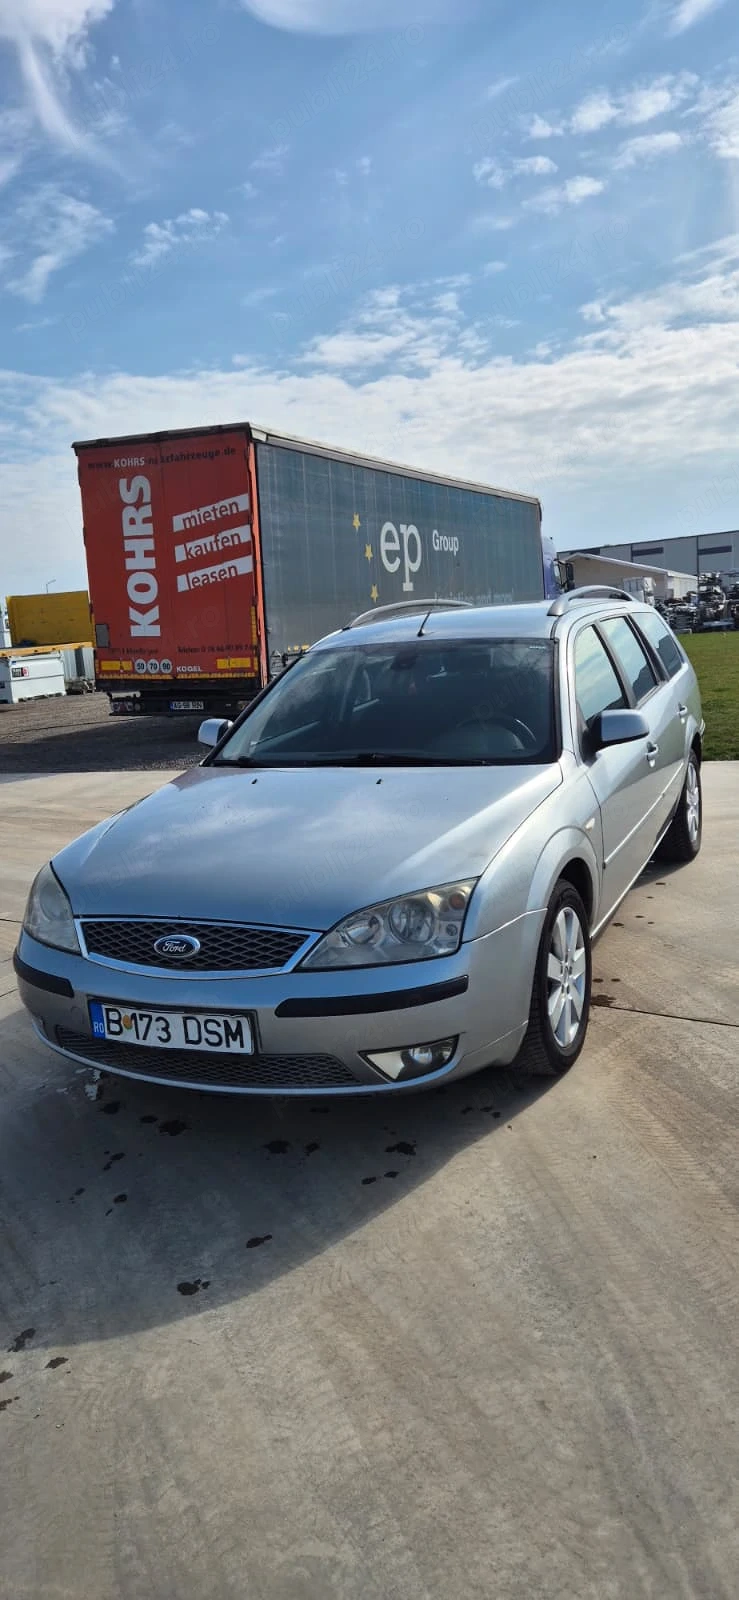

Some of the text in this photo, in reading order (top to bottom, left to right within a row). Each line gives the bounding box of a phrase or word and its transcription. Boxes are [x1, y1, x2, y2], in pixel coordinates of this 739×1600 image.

[182, 501, 239, 528] mieten
[119, 475, 161, 637] KOHRS
[184, 532, 241, 559] kaufen
[380, 521, 459, 591] ep Group
[186, 565, 238, 590] leasen
[149, 662, 157, 670] 70
[162, 940, 187, 952] Ford
[93, 1021, 104, 1034] RO
[104, 1008, 245, 1049] B 173 DSM
